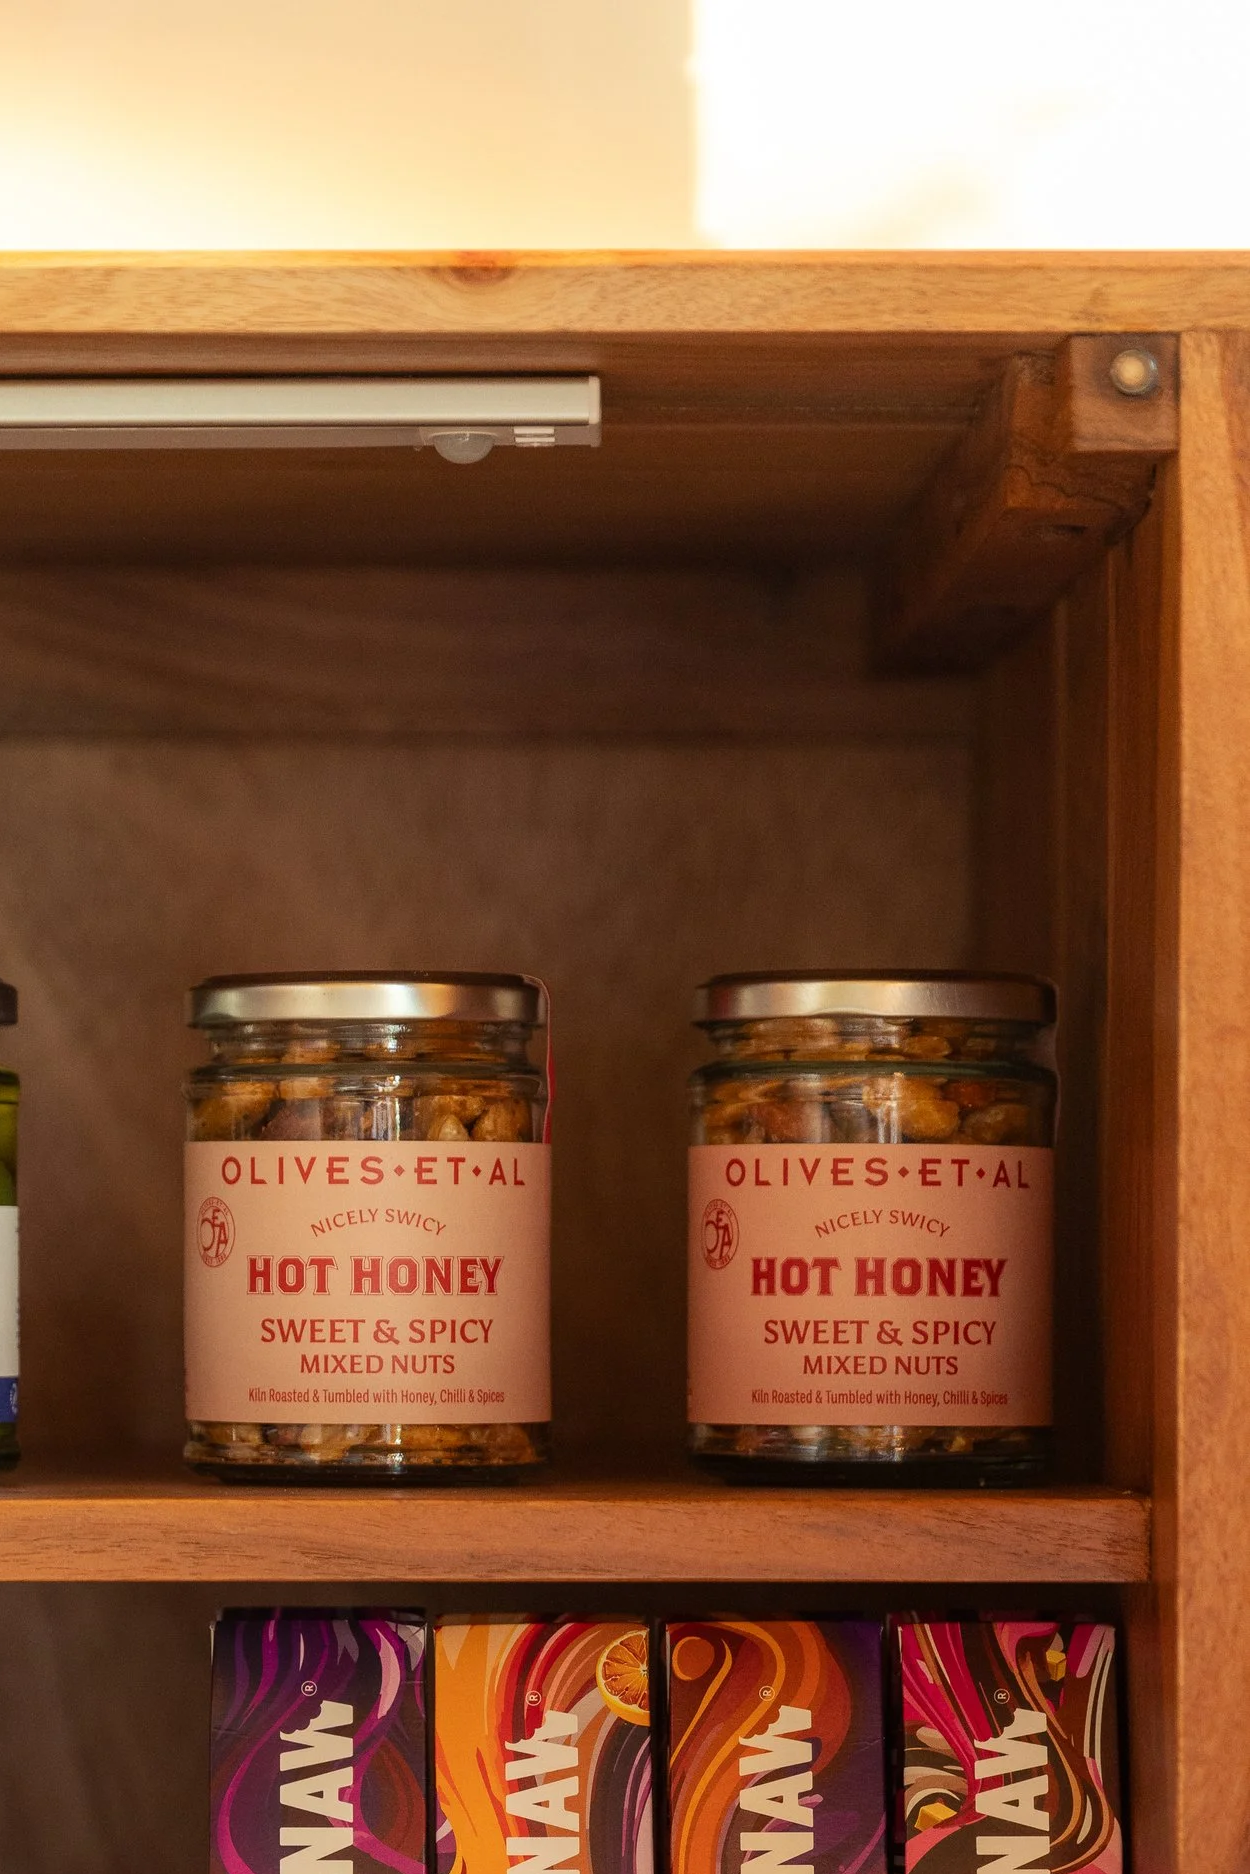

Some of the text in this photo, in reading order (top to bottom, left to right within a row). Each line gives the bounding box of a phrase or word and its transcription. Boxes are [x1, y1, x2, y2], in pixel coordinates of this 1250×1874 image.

[310, 1208, 447, 1237] NICELY SWICY
[814, 1209, 951, 1238] NICELY SWICY
[247, 1255, 505, 1295] HOT HONEY
[750, 1256, 1009, 1297] HOT HONEY
[260, 1318, 494, 1345] SWEET & SPICY
[764, 1320, 997, 1346] SWEET & SPICY
[300, 1354, 455, 1374] MIXED NUTS
[803, 1355, 959, 1375] MIXED NUTS
[248, 1388, 505, 1406] Kiln Roasted & Tumbled with Honey, Chilli & Spices
[751, 1390, 1008, 1407] Kiln Roasted & Tumbled with Honey, Chilli & Spices
